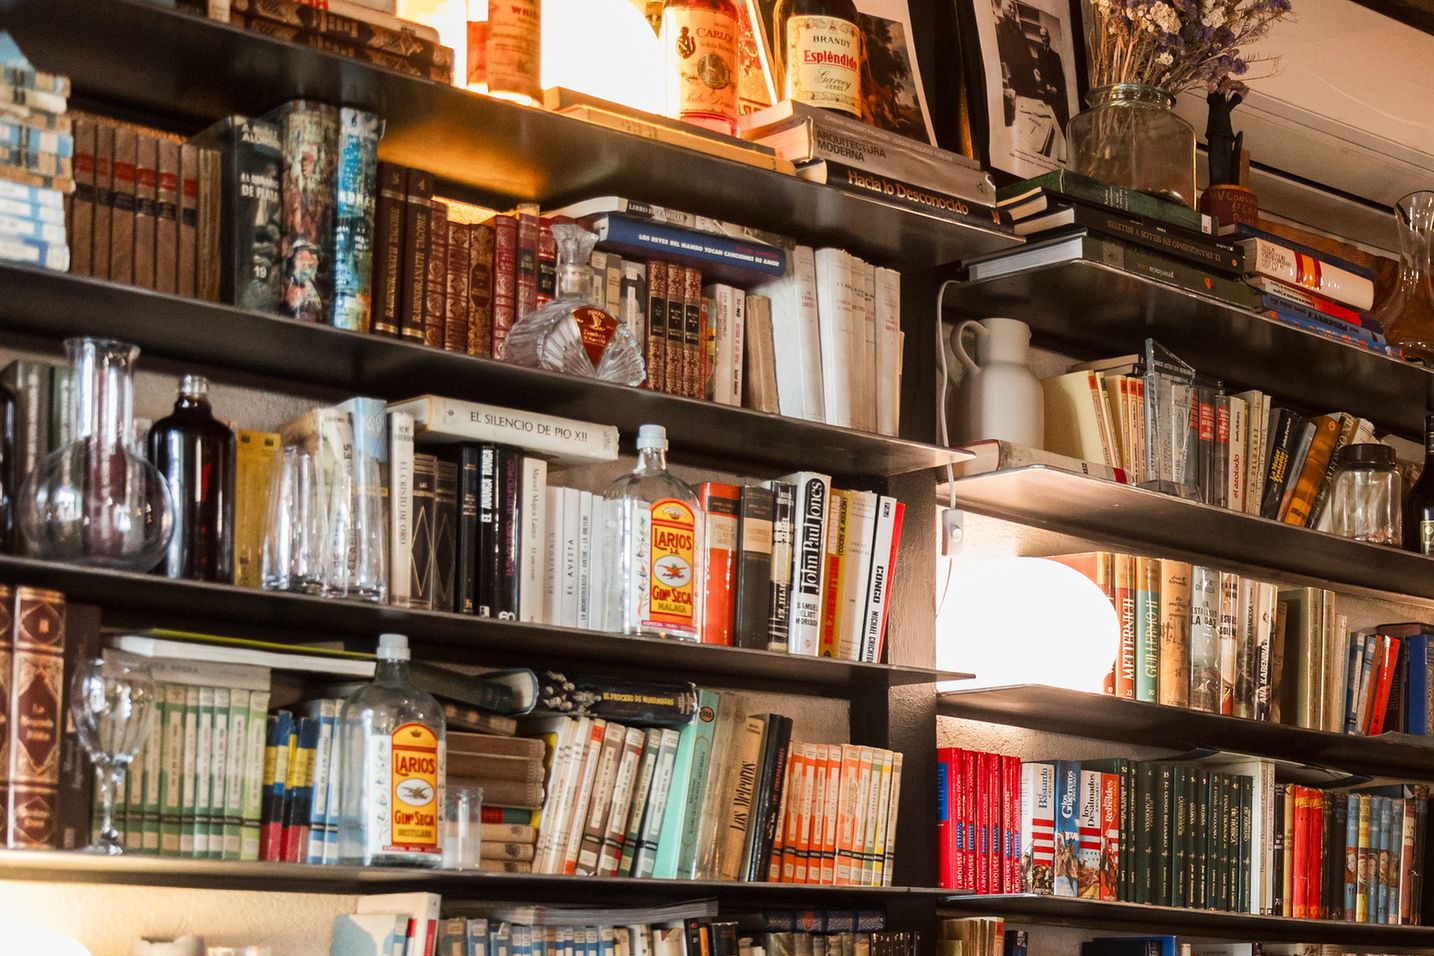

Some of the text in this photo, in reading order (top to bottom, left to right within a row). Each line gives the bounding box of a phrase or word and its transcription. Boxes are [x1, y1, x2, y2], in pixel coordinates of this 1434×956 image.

[813, 35, 851, 48] BRANDY
[803, 49, 858, 70] Espléndido
[815, 69, 852, 90] Garvey
[817, 130, 887, 158] ARQUITECTURA
[817, 139, 865, 162] MODERNA
[241, 184, 254, 197] DE
[847, 170, 969, 216] Hacia lo Desconocido
[638, 234, 650, 242] LOS
[651, 236, 668, 245] REYES
[669, 238, 681, 248] DEL
[681, 241, 704, 252] MAMBO
[704, 245, 723, 256] TOCAN
[723, 250, 755, 263] CANCIONES
[754, 256, 763, 264] DE
[763, 258, 780, 267] AMOR
[253, 265, 267, 279] 19
[470, 411, 588, 442] EL SILENCIO DE PIO XII
[1272, 448, 1280, 472] Mujer
[480, 448, 494, 524] EL ANANGA RANGA
[1232, 453, 1240, 499] el azotado
[654, 527, 692, 551] LARIOS
[800, 481, 823, 589] John Paul Jones
[566, 586, 573, 596] EL
[671, 588, 693, 606] SECA
[872, 565, 884, 604] CONGO
[869, 610, 879, 636] MICHAEL
[1122, 597, 1135, 681] METTERNICH
[1145, 609, 1158, 678] GUILLERMO
[1259, 645, 1269, 704] ANA KARENINA
[602, 692, 611, 700] EL
[611, 692, 635, 702] PROCESO
[635, 694, 642, 702] DE
[394, 752, 436, 777] LARIOS
[733, 760, 757, 807] Meteoros
[1038, 767, 1048, 809] Bastardo
[1061, 770, 1074, 819] Guerreros
[1082, 805, 1090, 818] los
[1087, 773, 1095, 827] Desalmados
[1104, 780, 1113, 823] Rebeldes
[415, 811, 435, 827] SECA
[729, 810, 748, 832] Los
[967, 854, 975, 890] LAROUSSE
